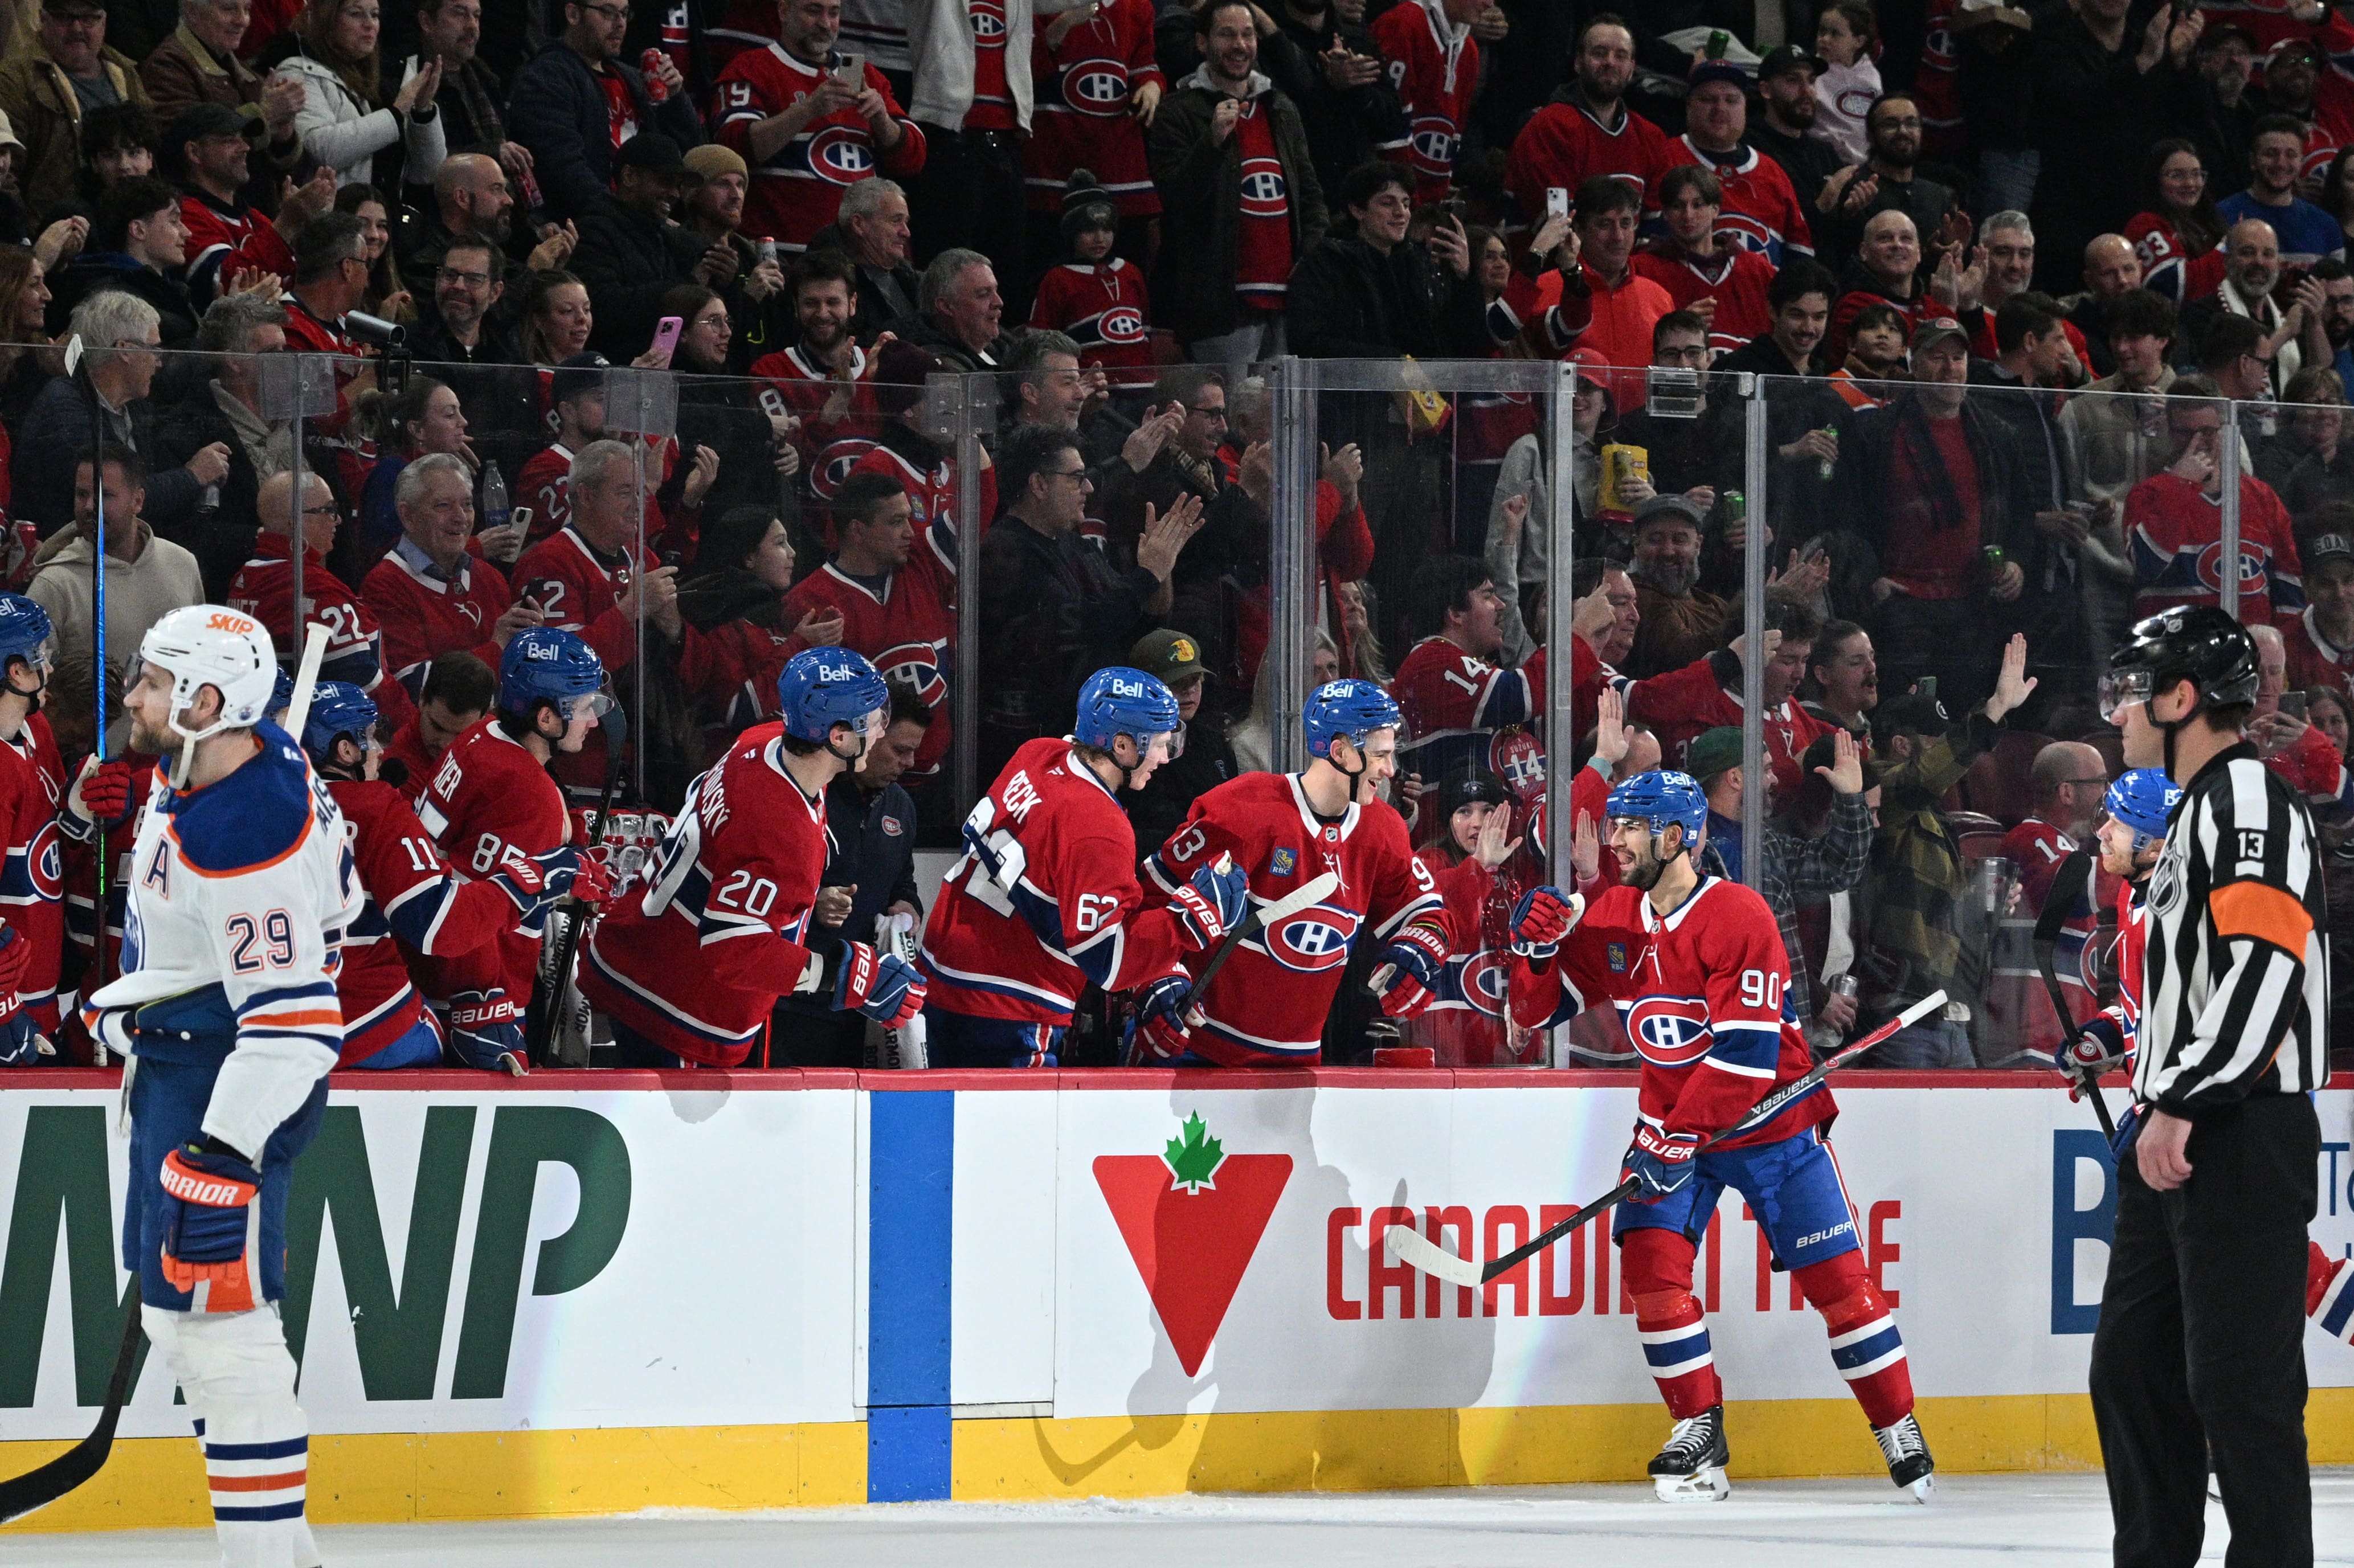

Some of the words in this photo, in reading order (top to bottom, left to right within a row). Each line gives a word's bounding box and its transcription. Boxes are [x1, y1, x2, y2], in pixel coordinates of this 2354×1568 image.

[2135, 230, 2171, 266] 33
[206, 613, 254, 636] SKIP
[320, 603, 365, 645] 22
[528, 642, 559, 661] Bell
[819, 664, 851, 682] Bell
[1113, 678, 1143, 698] Bell
[1444, 656, 1491, 697] 14
[311, 684, 340, 703] Bell
[1323, 683, 1354, 698] Bell
[1509, 741, 1534, 754] SUZUKI
[1510, 749, 1545, 787] 14
[1661, 769, 1690, 787] Bell
[1002, 769, 1043, 825] BECK
[1688, 830, 1698, 840] 29
[2034, 834, 2077, 863] 14
[2238, 832, 2264, 859] 13
[142, 833, 170, 901] A
[400, 837, 441, 871] 11
[472, 832, 526, 873] 85
[1272, 866, 1290, 875] RBC
[717, 869, 779, 917] 20
[1076, 893, 1119, 932] 62
[226, 908, 296, 976] 29
[1741, 968, 1780, 1011] 90
[451, 1000, 514, 1025] BAUER
[1763, 1075, 1811, 1112] BAUER
[1637, 1128, 1696, 1160] BAUER
[1796, 1221, 1854, 1248] BAUER
[1327, 1203, 1721, 1321] CANADI
[1742, 1199, 1901, 1312] TE
